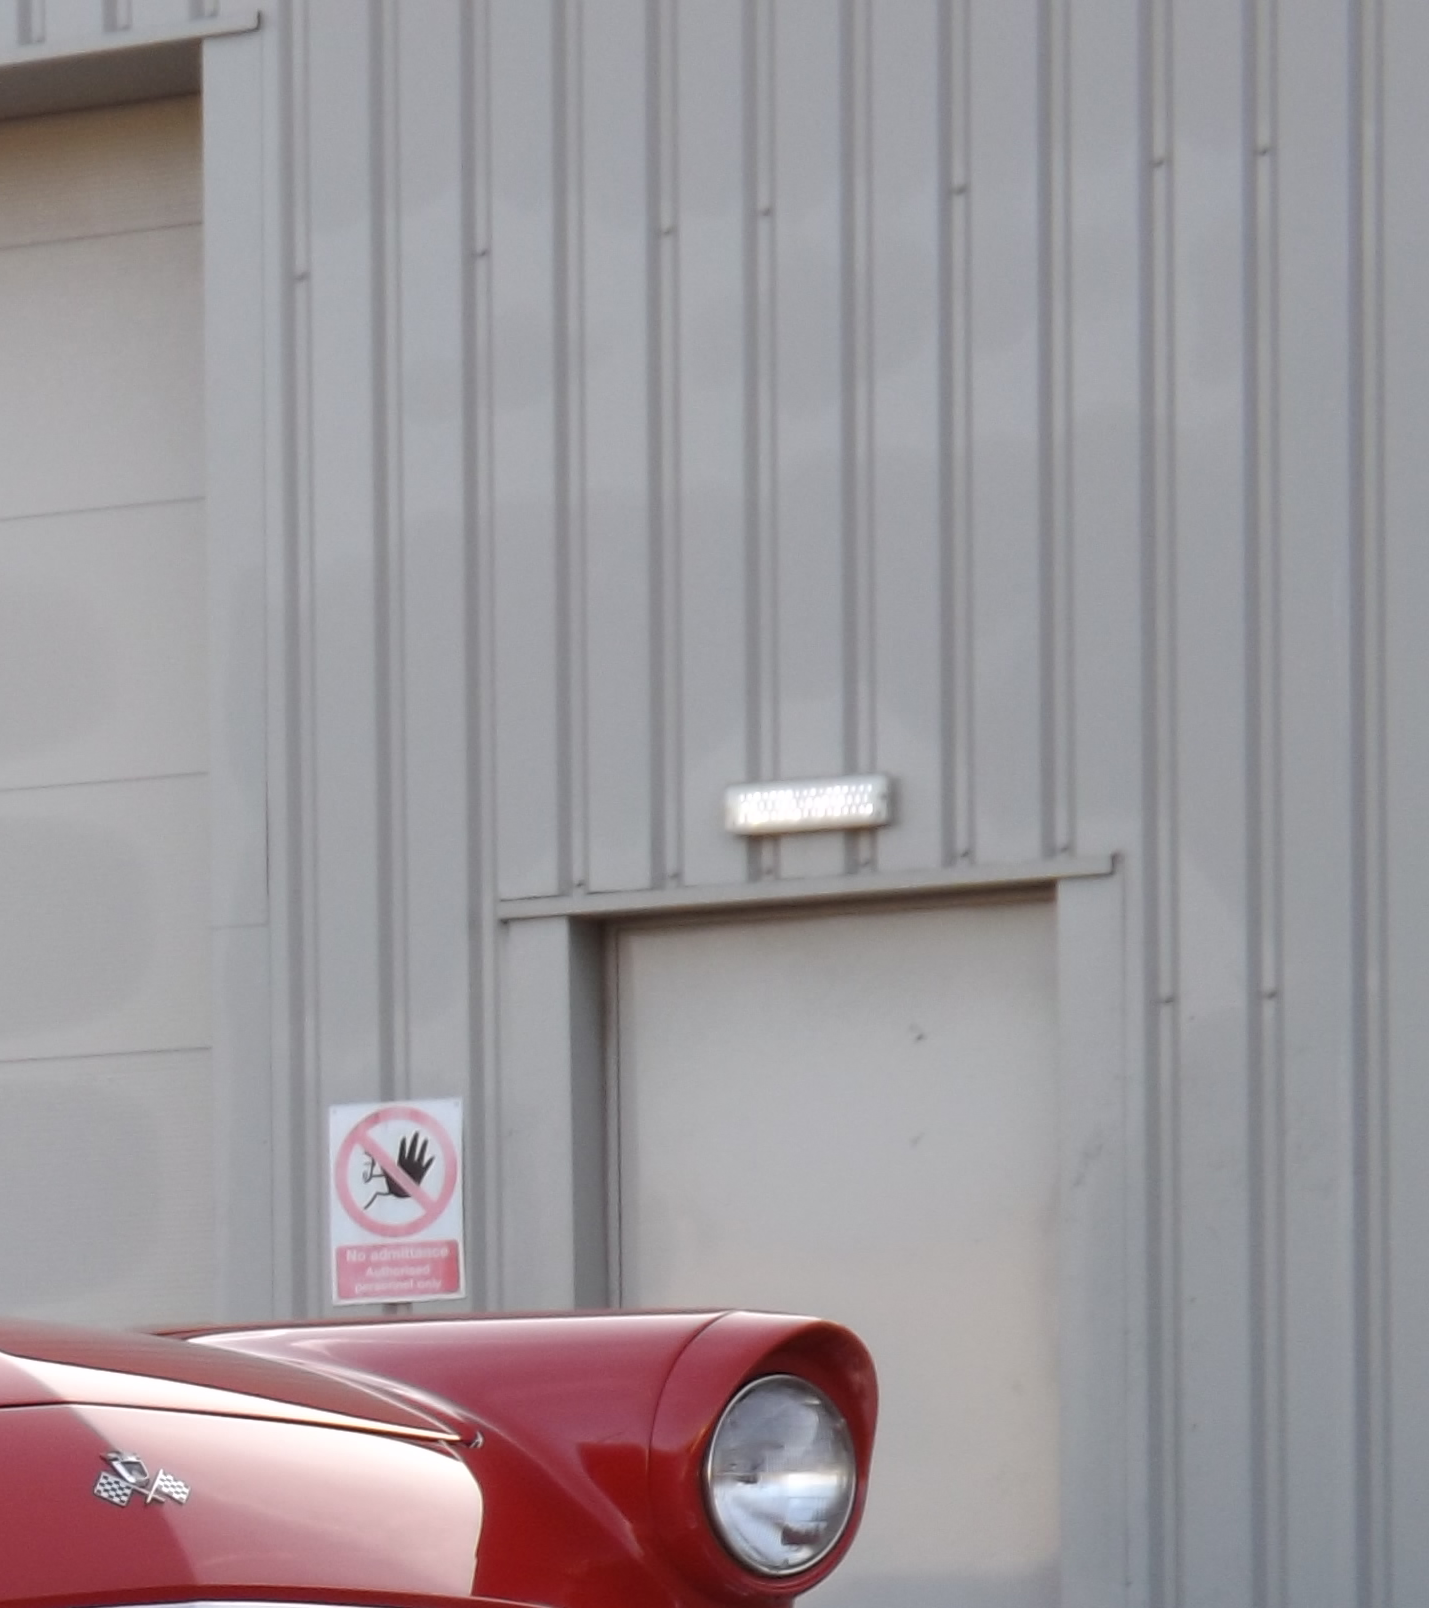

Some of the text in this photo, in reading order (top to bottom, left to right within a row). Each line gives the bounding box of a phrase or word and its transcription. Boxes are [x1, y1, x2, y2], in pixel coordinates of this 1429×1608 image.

[346, 1246, 449, 1262] No admittance
[354, 1279, 442, 1295] personnel only
